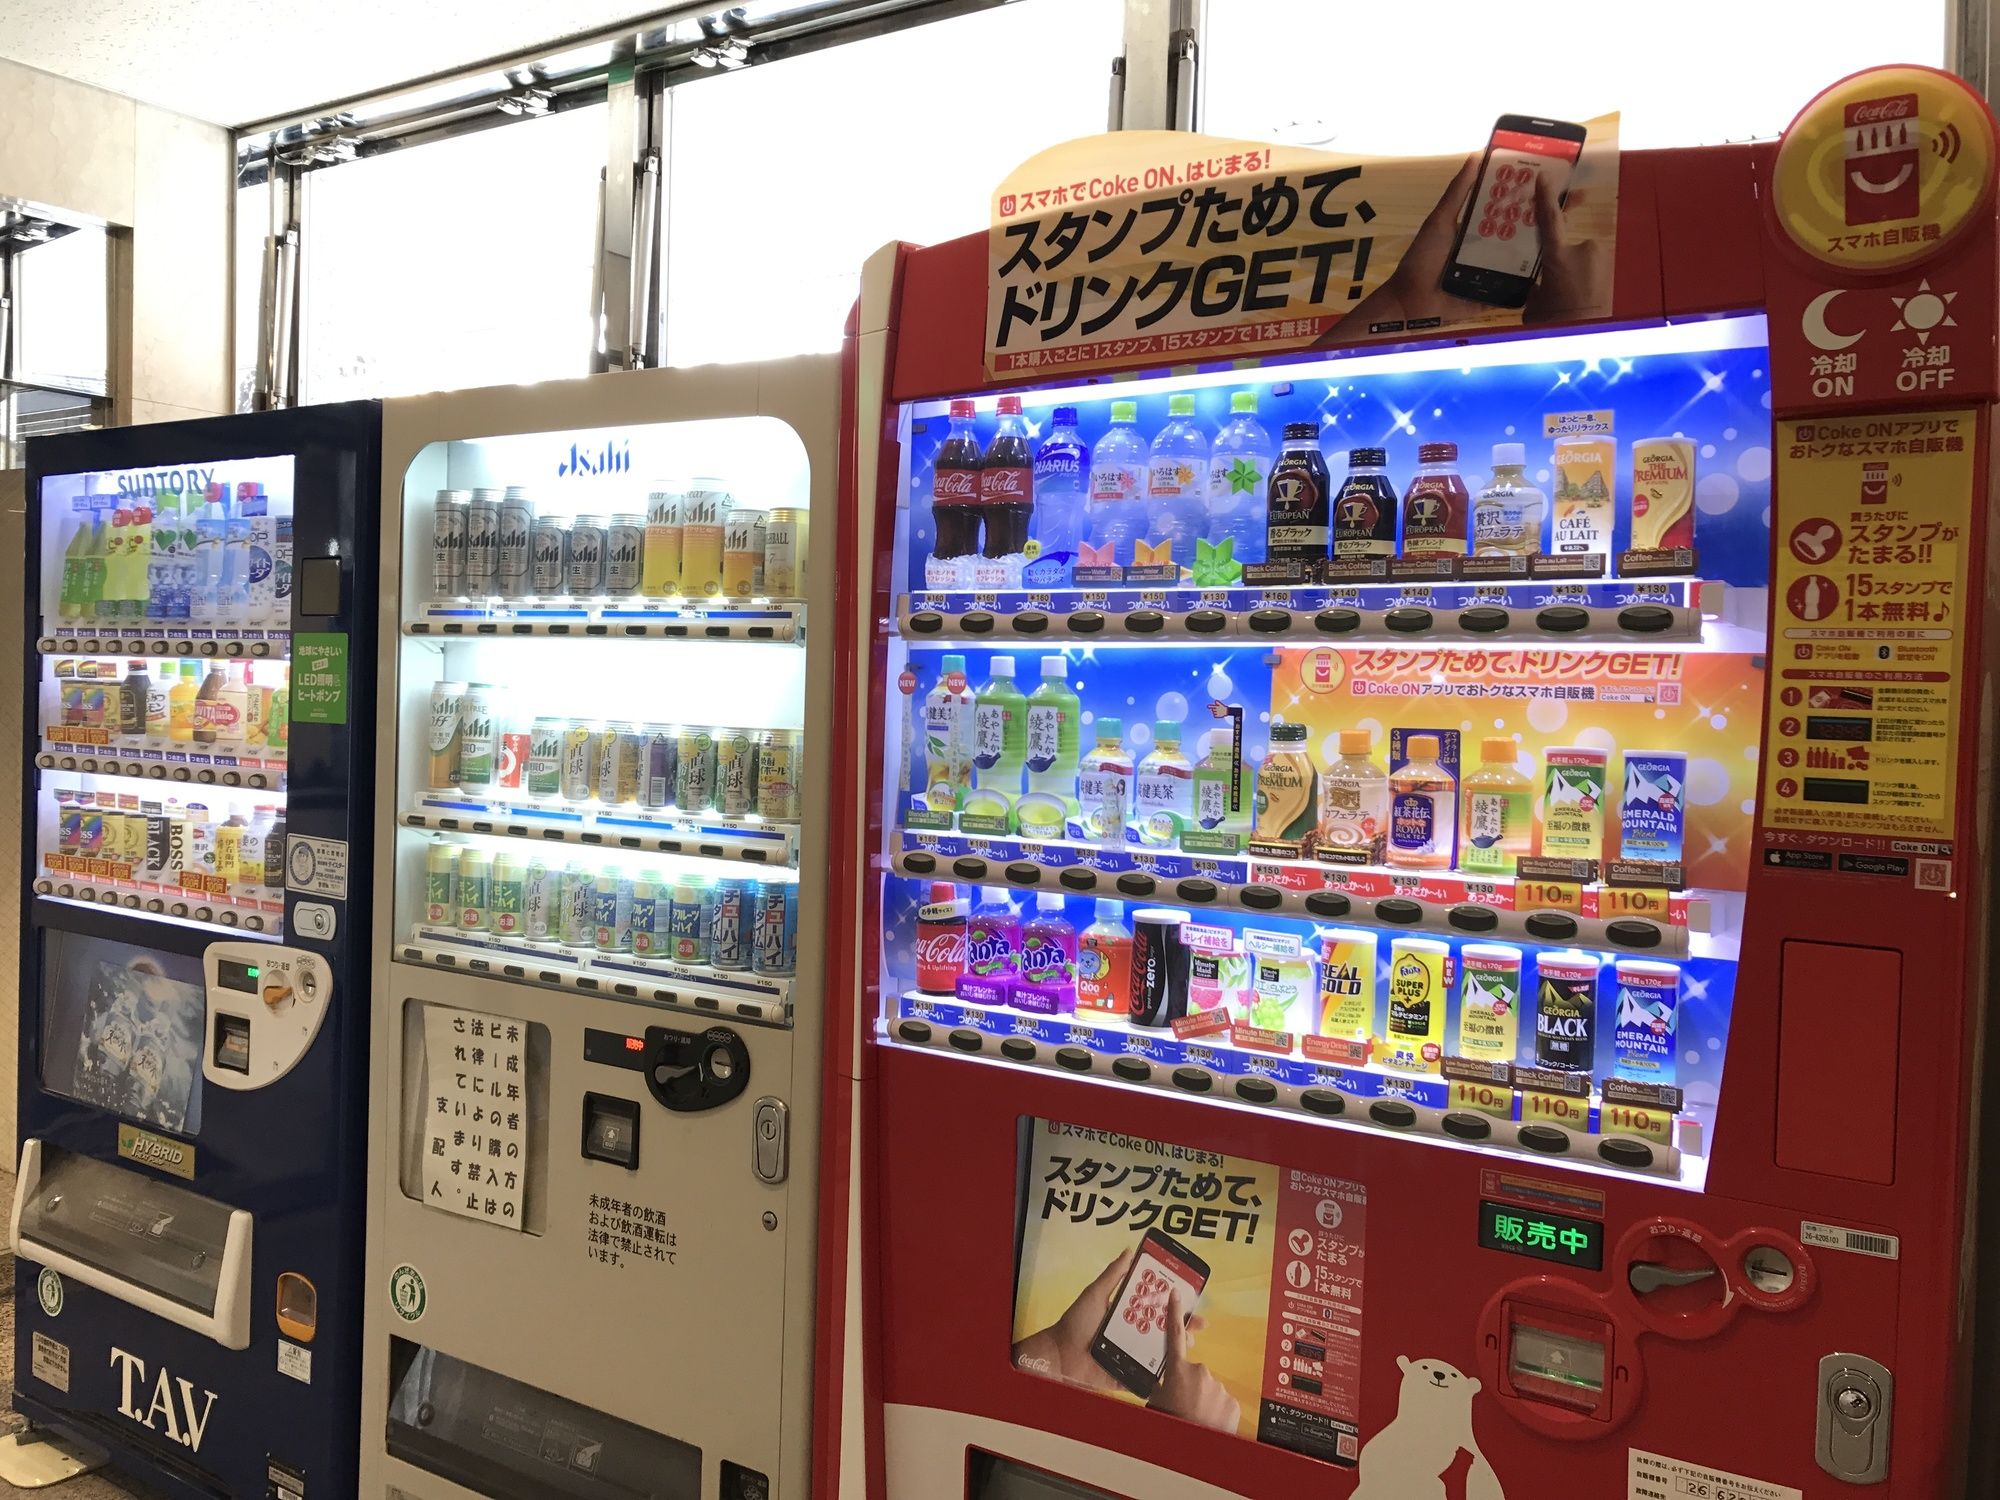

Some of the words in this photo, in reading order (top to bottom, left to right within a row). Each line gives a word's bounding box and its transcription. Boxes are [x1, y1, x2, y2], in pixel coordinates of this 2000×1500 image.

[1854, 100, 1909, 122] Coca-Cola
[1020, 175, 1139, 211] スマホでCoke
[998, 165, 1377, 278] スタンプためて、
[1827, 223, 1942, 253] スマホ自販機
[996, 236, 1374, 347] ドリンクGET!
[1810, 353, 1857, 376] 冷却
[1901, 345, 1950, 368] 冷却
[1812, 376, 1855, 398] ON
[1896, 368, 1955, 392] OFF
[1818, 424, 1861, 440] Coke
[1866, 419, 1959, 439] ONアプリで
[1789, 436, 1965, 459] おトクなスマホ自販機
[558, 439, 630, 477] Asahi
[1649, 463, 1666, 471] THE
[118, 468, 215, 498] SUNTORY
[1634, 466, 1688, 481] PREMIUM
[1269, 509, 1311, 521] EUROPEAN
[1559, 516, 1591, 530] CAFÉ
[1335, 529, 1373, 538] EUROPEAN
[1476, 526, 1524, 538] カフェラテ
[1555, 531, 1567, 541] AU
[1569, 529, 1599, 541] LAIT
[1849, 521, 1959, 543] スタンプが
[1328, 562, 1347, 570] Black
[1624, 554, 1653, 562] Coffee
[1846, 573, 1953, 597] 15スタンプで
[1354, 649, 1681, 676] スタンプためて、ドリンクGET!
[948, 679, 965, 687] NEW
[1368, 682, 1399, 695] Coke
[1402, 682, 1595, 700] ONアプリでおトクなスマホ自販機
[298, 689, 341, 703] ヒートポンプ
[1785, 720, 1795, 734] 2
[1784, 751, 1793, 764] 3
[1780, 782, 1791, 794] 4
[1393, 805, 1431, 819] 紅茶花伝
[1622, 809, 1675, 821] EMERALD
[1395, 825, 1426, 835] ROYAL
[171, 824, 183, 871] BOSS
[1894, 842, 1919, 852] Coke
[1920, 843, 1936, 852] ON
[1613, 865, 1641, 874] Coffee
[1855, 861, 1886, 872] Google
[1887, 864, 1905, 873] Play
[1393, 877, 1418, 886] ¥130
[1466, 883, 1493, 893] ¥130
[1524, 884, 1572, 904] 110円
[1608, 892, 1659, 911] 110円
[500, 917, 515, 927] お酒
[1147, 956, 1156, 989] zero
[1444, 959, 1455, 986] NEW
[1081, 980, 1100, 993] Qoo
[1396, 979, 1424, 989] SUPER
[1398, 988, 1421, 996] PLUS
[1537, 1013, 1588, 1037] BLACK
[1307, 1038, 1330, 1049] Energy
[1331, 1040, 1348, 1050] Drink
[1615, 1040, 1668, 1055] MOUNTAIN
[1617, 1030, 1666, 1045] EMERALD
[1383, 1057, 1428, 1069] ビタミンチャージ
[1396, 1050, 1414, 1061] 爽快
[1516, 1070, 1537, 1079] Black
[1538, 1073, 1564, 1083] Coffee
[1458, 1084, 1504, 1108] 110円
[1609, 1083, 1638, 1092] Coffee
[451, 1016, 467, 1195] されています。
[466, 1017, 484, 1211] 法律により禁止
[1532, 1096, 1580, 1119] 110円
[485, 1018, 502, 1214] ビールの購入は
[503, 1024, 519, 1218] 未成年者の方の
[1611, 1108, 1661, 1132] 110円
[430, 1097, 448, 1198] 支配人
[1062, 1123, 1143, 1152] スマホでCoke
[132, 1137, 183, 1164] HYBRID
[1044, 1156, 1263, 1208] スタンプためて、
[1301, 1173, 1322, 1185] Coke
[1324, 1177, 1367, 1193] ONアプリで
[589, 1193, 667, 1226] 未成年者の飲酒
[1041, 1187, 1260, 1245] ドリンクGET!
[589, 1211, 677, 1247] および飲酒運転は
[1494, 1214, 1588, 1255] 販売中
[588, 1229, 677, 1265] 法律で禁止されて
[588, 1247, 625, 1269] います。
[1317, 1250, 1347, 1266] たまる
[1315, 1265, 1362, 1288] 15スタンプで
[1314, 1279, 1352, 1299] 1本無料
[1017, 1354, 1049, 1371] Coca-Cola
[1688, 1482, 1709, 1496] 26
